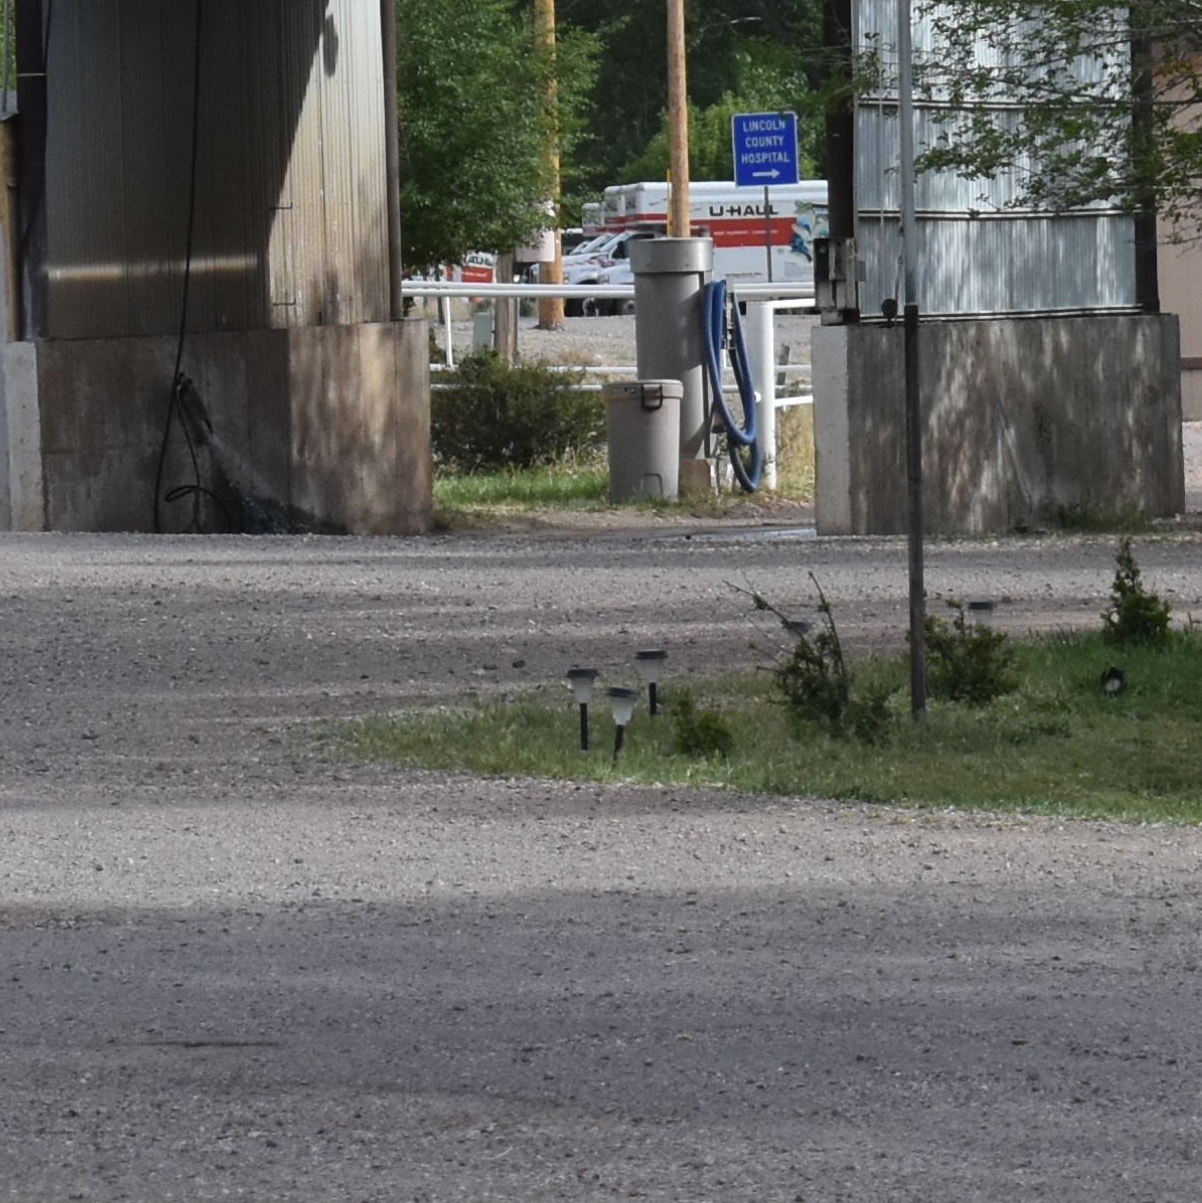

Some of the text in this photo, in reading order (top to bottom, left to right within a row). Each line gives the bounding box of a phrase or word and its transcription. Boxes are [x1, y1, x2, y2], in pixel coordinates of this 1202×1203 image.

[742, 119, 786, 132] LINCOLN
[745, 135, 784, 147] COUNTY
[741, 152, 790, 164] HOSPITAL
[709, 205, 777, 216] U-HAUL
